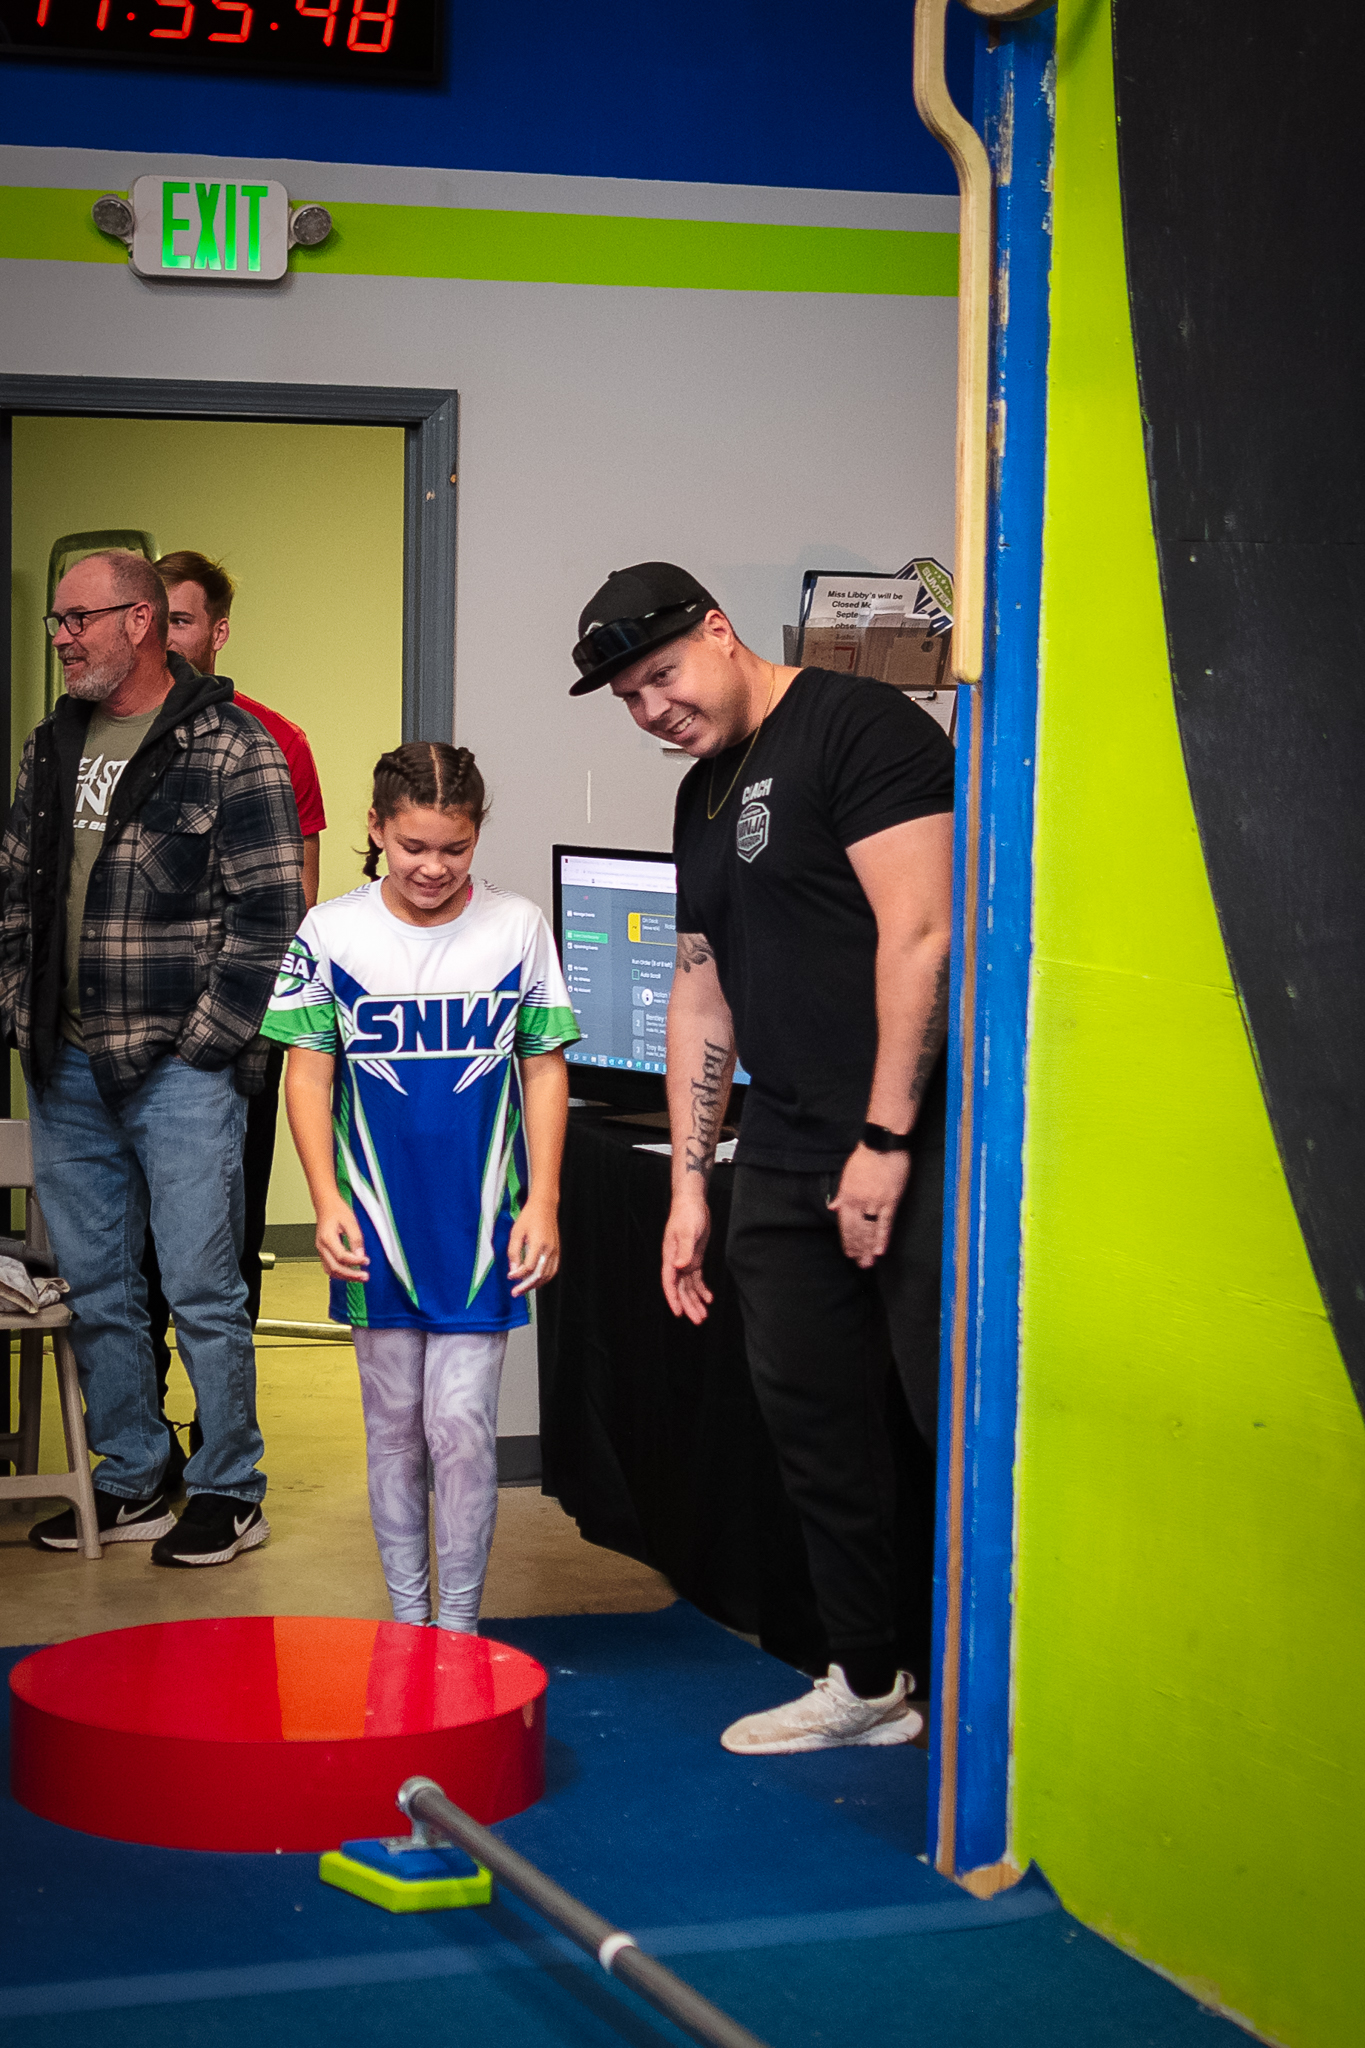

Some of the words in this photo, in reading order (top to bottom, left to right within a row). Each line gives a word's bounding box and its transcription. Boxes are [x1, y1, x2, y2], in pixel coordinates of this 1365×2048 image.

[161, 180, 269, 272] EXIT
[827, 590, 846, 598] Miss
[847, 591, 876, 600] Libby's
[878, 592, 892, 600] will
[345, 993, 515, 1057] SNW
